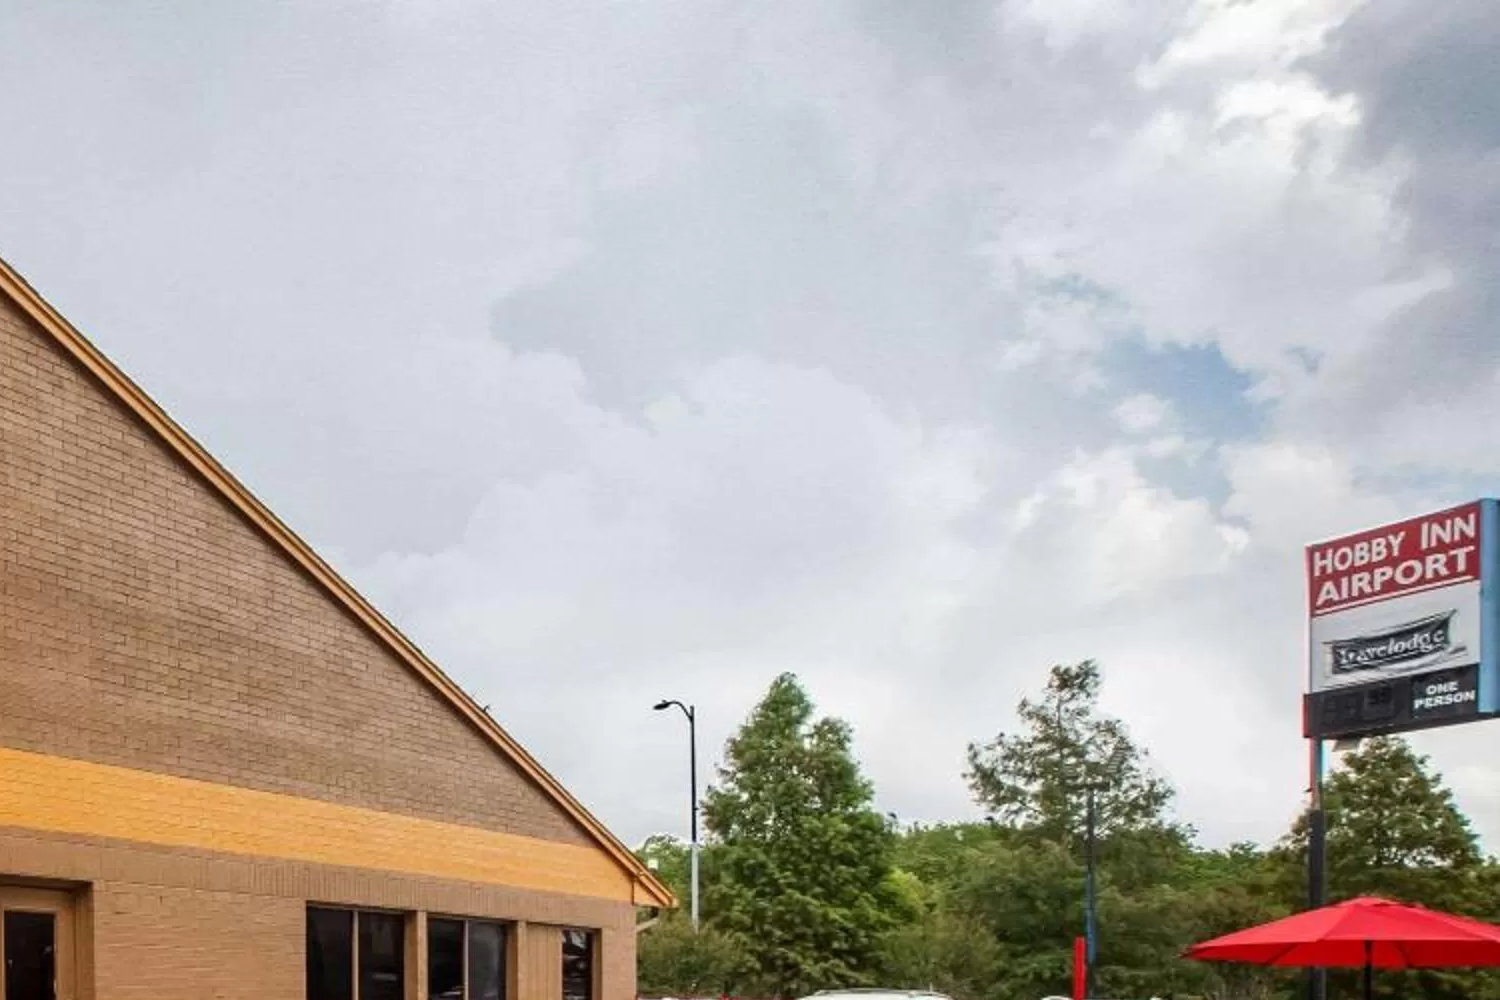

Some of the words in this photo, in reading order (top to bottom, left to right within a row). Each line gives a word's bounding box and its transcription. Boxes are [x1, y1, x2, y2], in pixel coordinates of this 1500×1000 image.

[1314, 531, 1406, 577] HOBBY
[1421, 512, 1476, 550] INN
[1316, 546, 1475, 607] AIRPORT
[1414, 690, 1476, 709] PERSON
[1426, 681, 1460, 694] ONE
